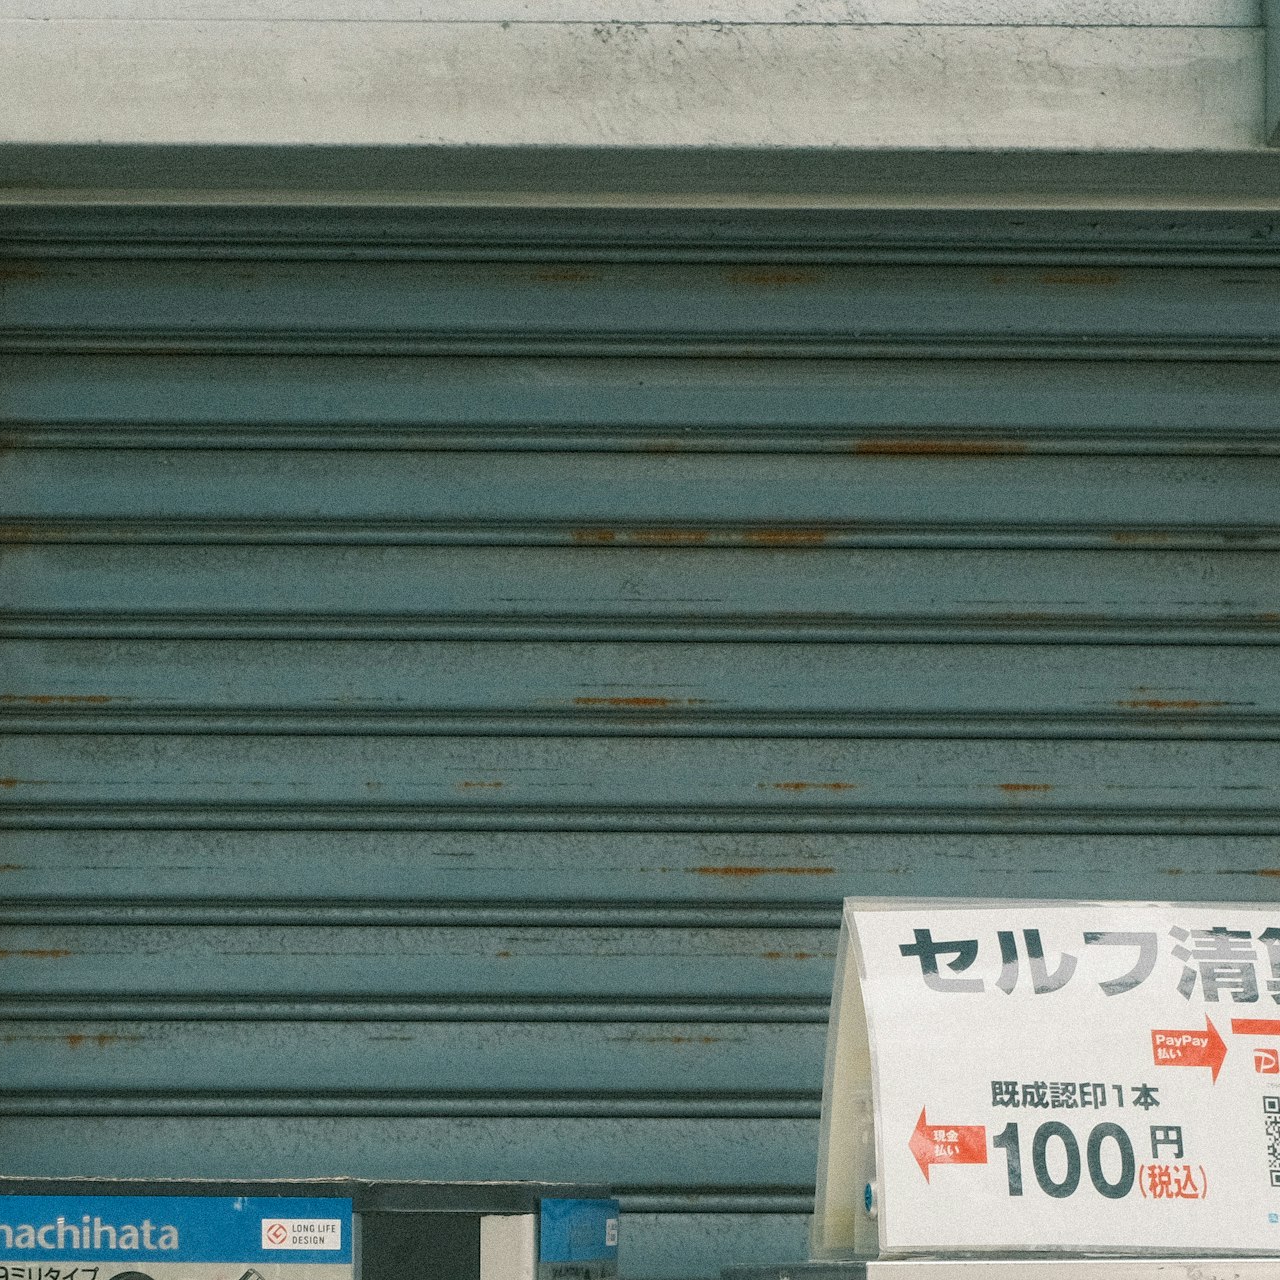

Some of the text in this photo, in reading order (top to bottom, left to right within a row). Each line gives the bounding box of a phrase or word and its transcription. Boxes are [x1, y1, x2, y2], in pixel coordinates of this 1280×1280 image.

[1155, 1034, 1209, 1048] PayPay
[1157, 1047, 1182, 1060] 払い
[990, 1080, 1161, 1110] 既成認印1本
[933, 1129, 959, 1142] 現金
[1150, 1125, 1184, 1159] 円
[935, 1144, 960, 1157] 払い
[992, 1121, 1136, 1200] 100
[1139, 1164, 1208, 1200] (税込)
[292, 1224, 336, 1233] LONG LIFE
[292, 1236, 325, 1244] DESIGN
